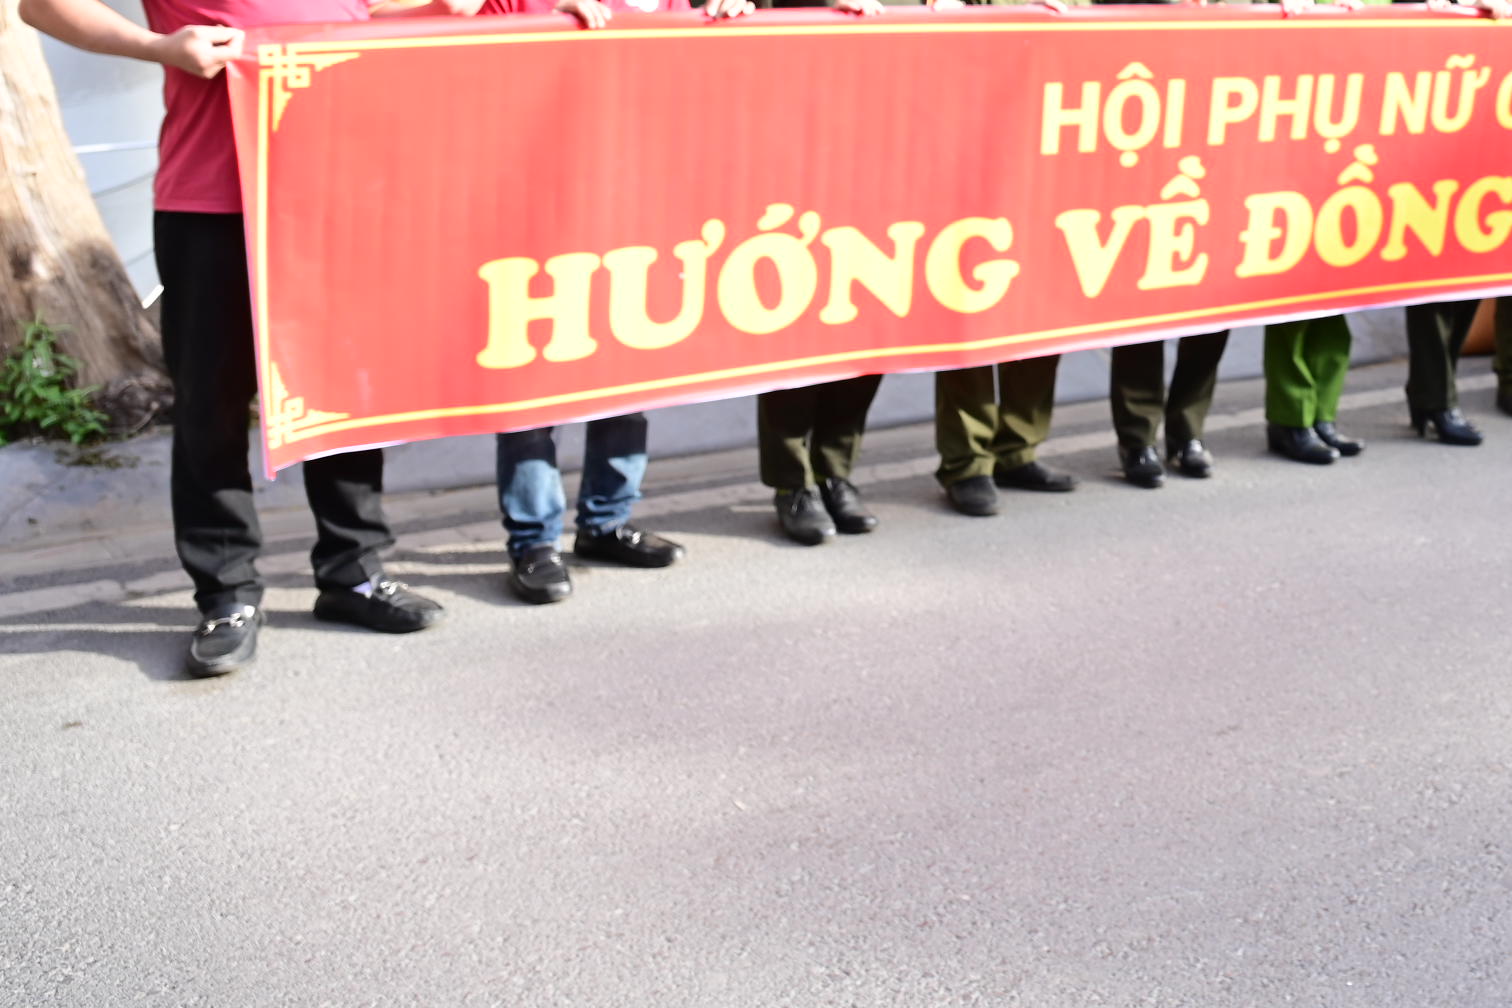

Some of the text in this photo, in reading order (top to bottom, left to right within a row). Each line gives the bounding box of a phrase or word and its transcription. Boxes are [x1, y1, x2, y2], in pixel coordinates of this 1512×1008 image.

[1040, 60, 1187, 168] HỘI
[1207, 72, 1364, 153] PHỤ
[1379, 53, 1491, 137] NỮ
[476, 203, 1020, 370] HƯỚNG
[1056, 154, 1209, 298] VỀ
